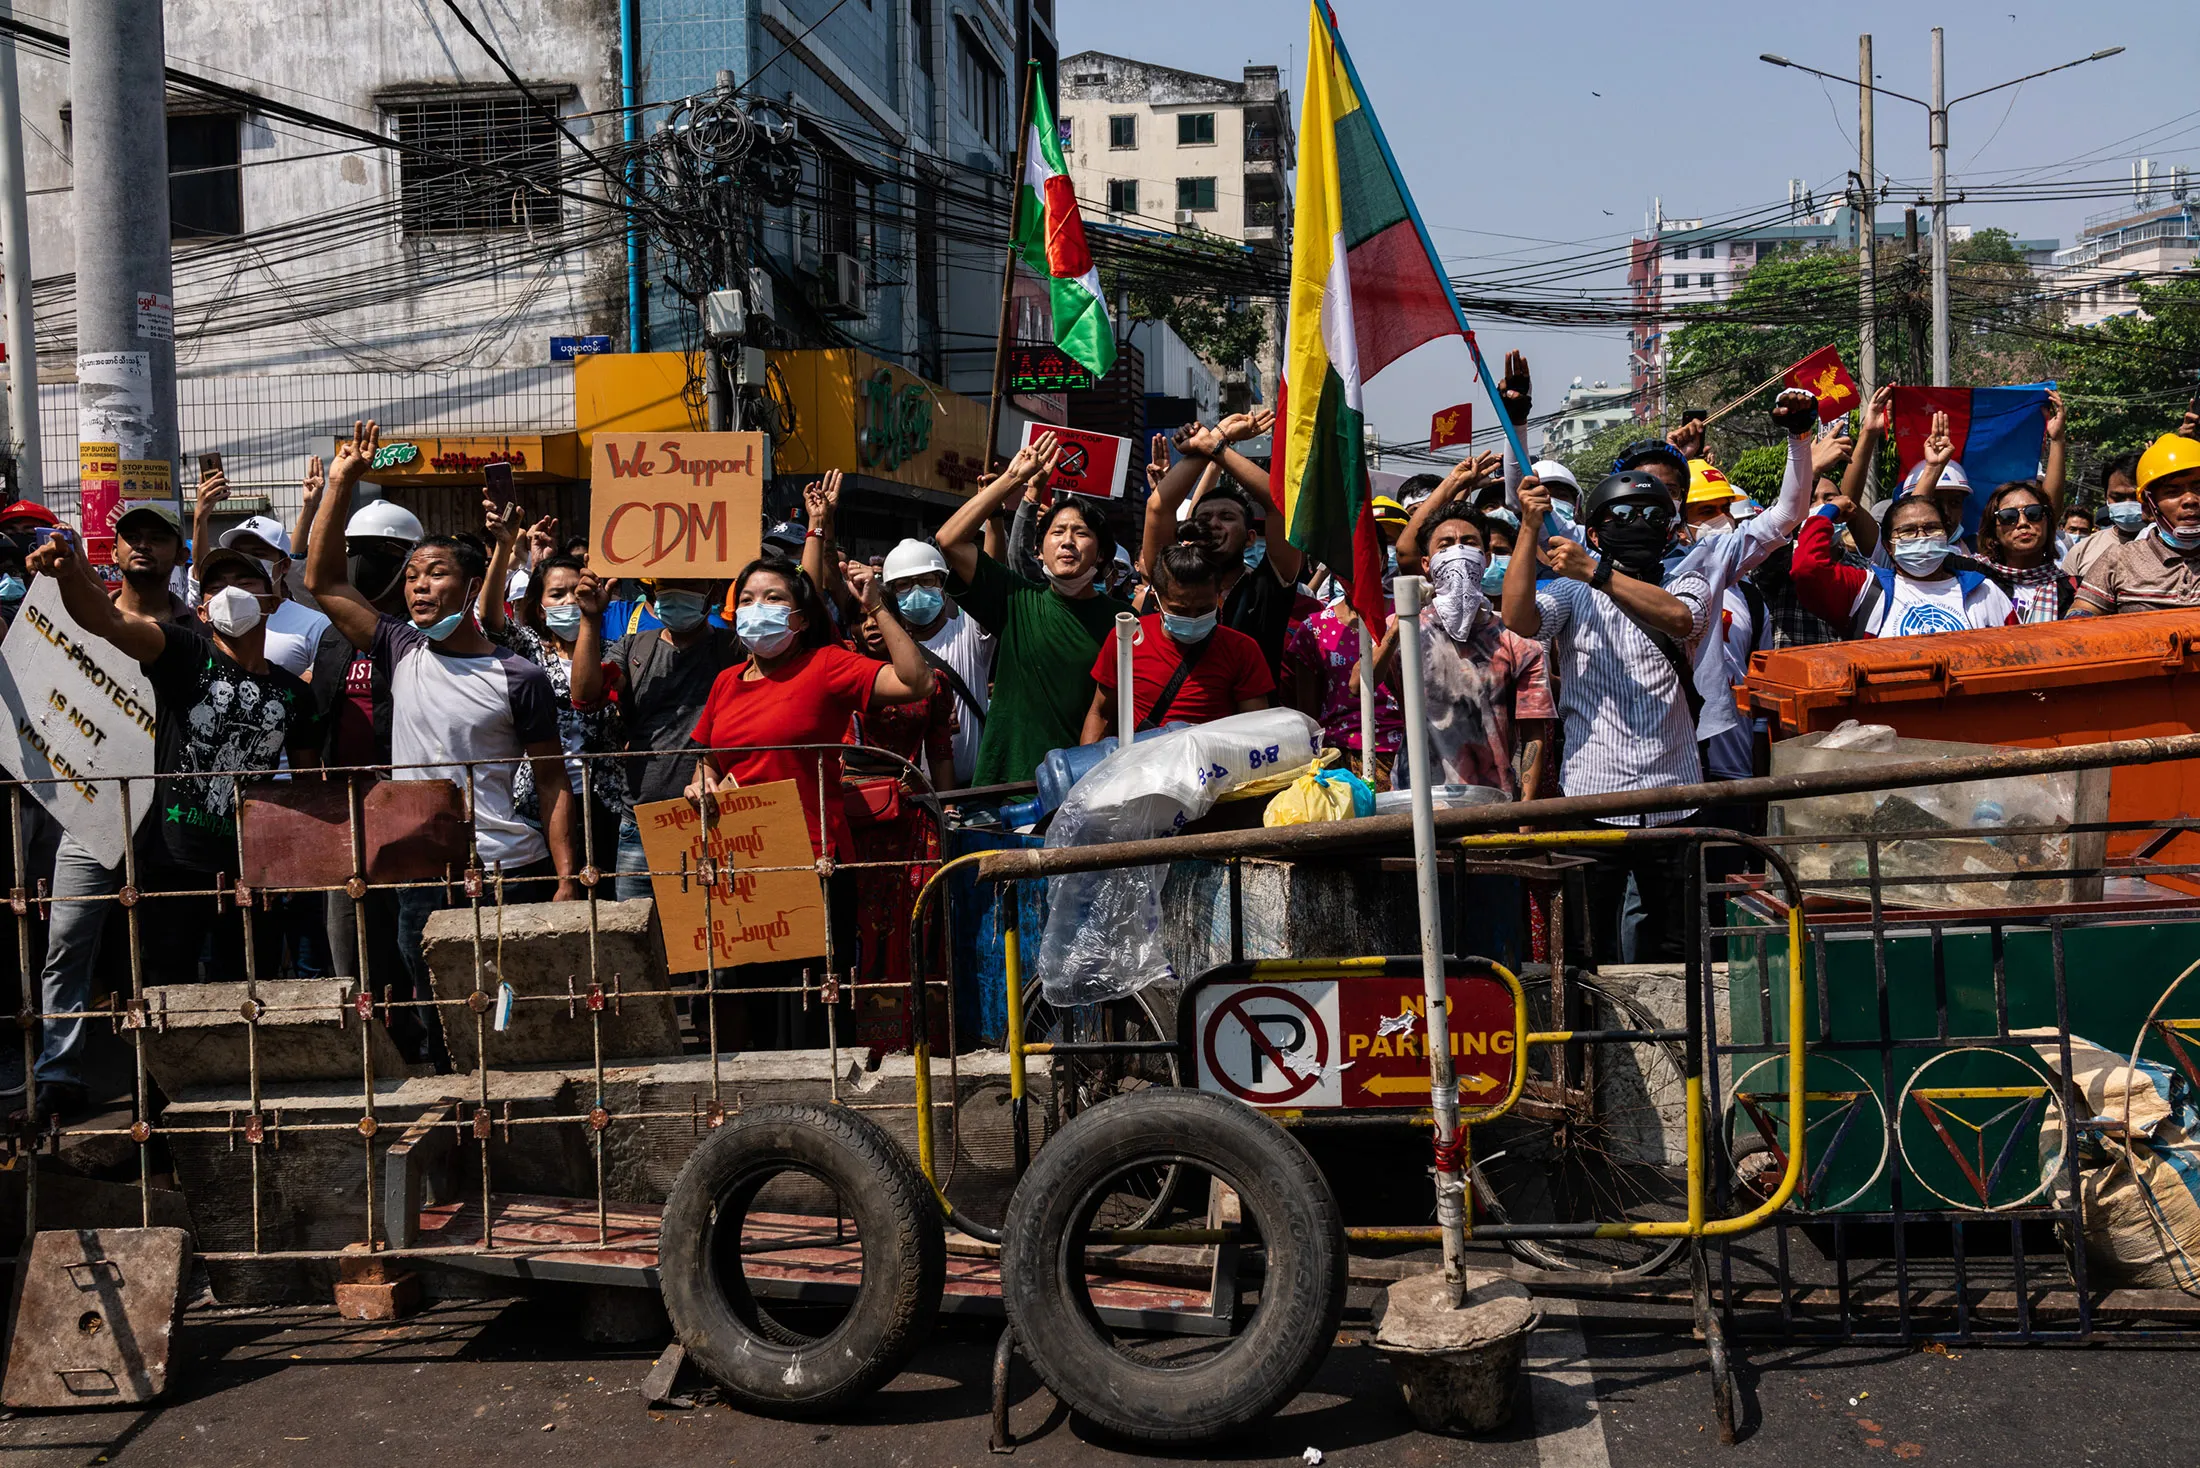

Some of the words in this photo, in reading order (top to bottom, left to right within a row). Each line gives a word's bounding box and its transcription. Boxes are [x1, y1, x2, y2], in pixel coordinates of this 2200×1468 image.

[605, 441, 656, 479] We
[656, 441, 755, 487] Support
[1057, 476, 1079, 489] END
[601, 501, 728, 568] CDM
[49, 688, 67, 713] IS
[68, 706, 107, 747] NOT
[19, 716, 99, 804] VIOLENCE
